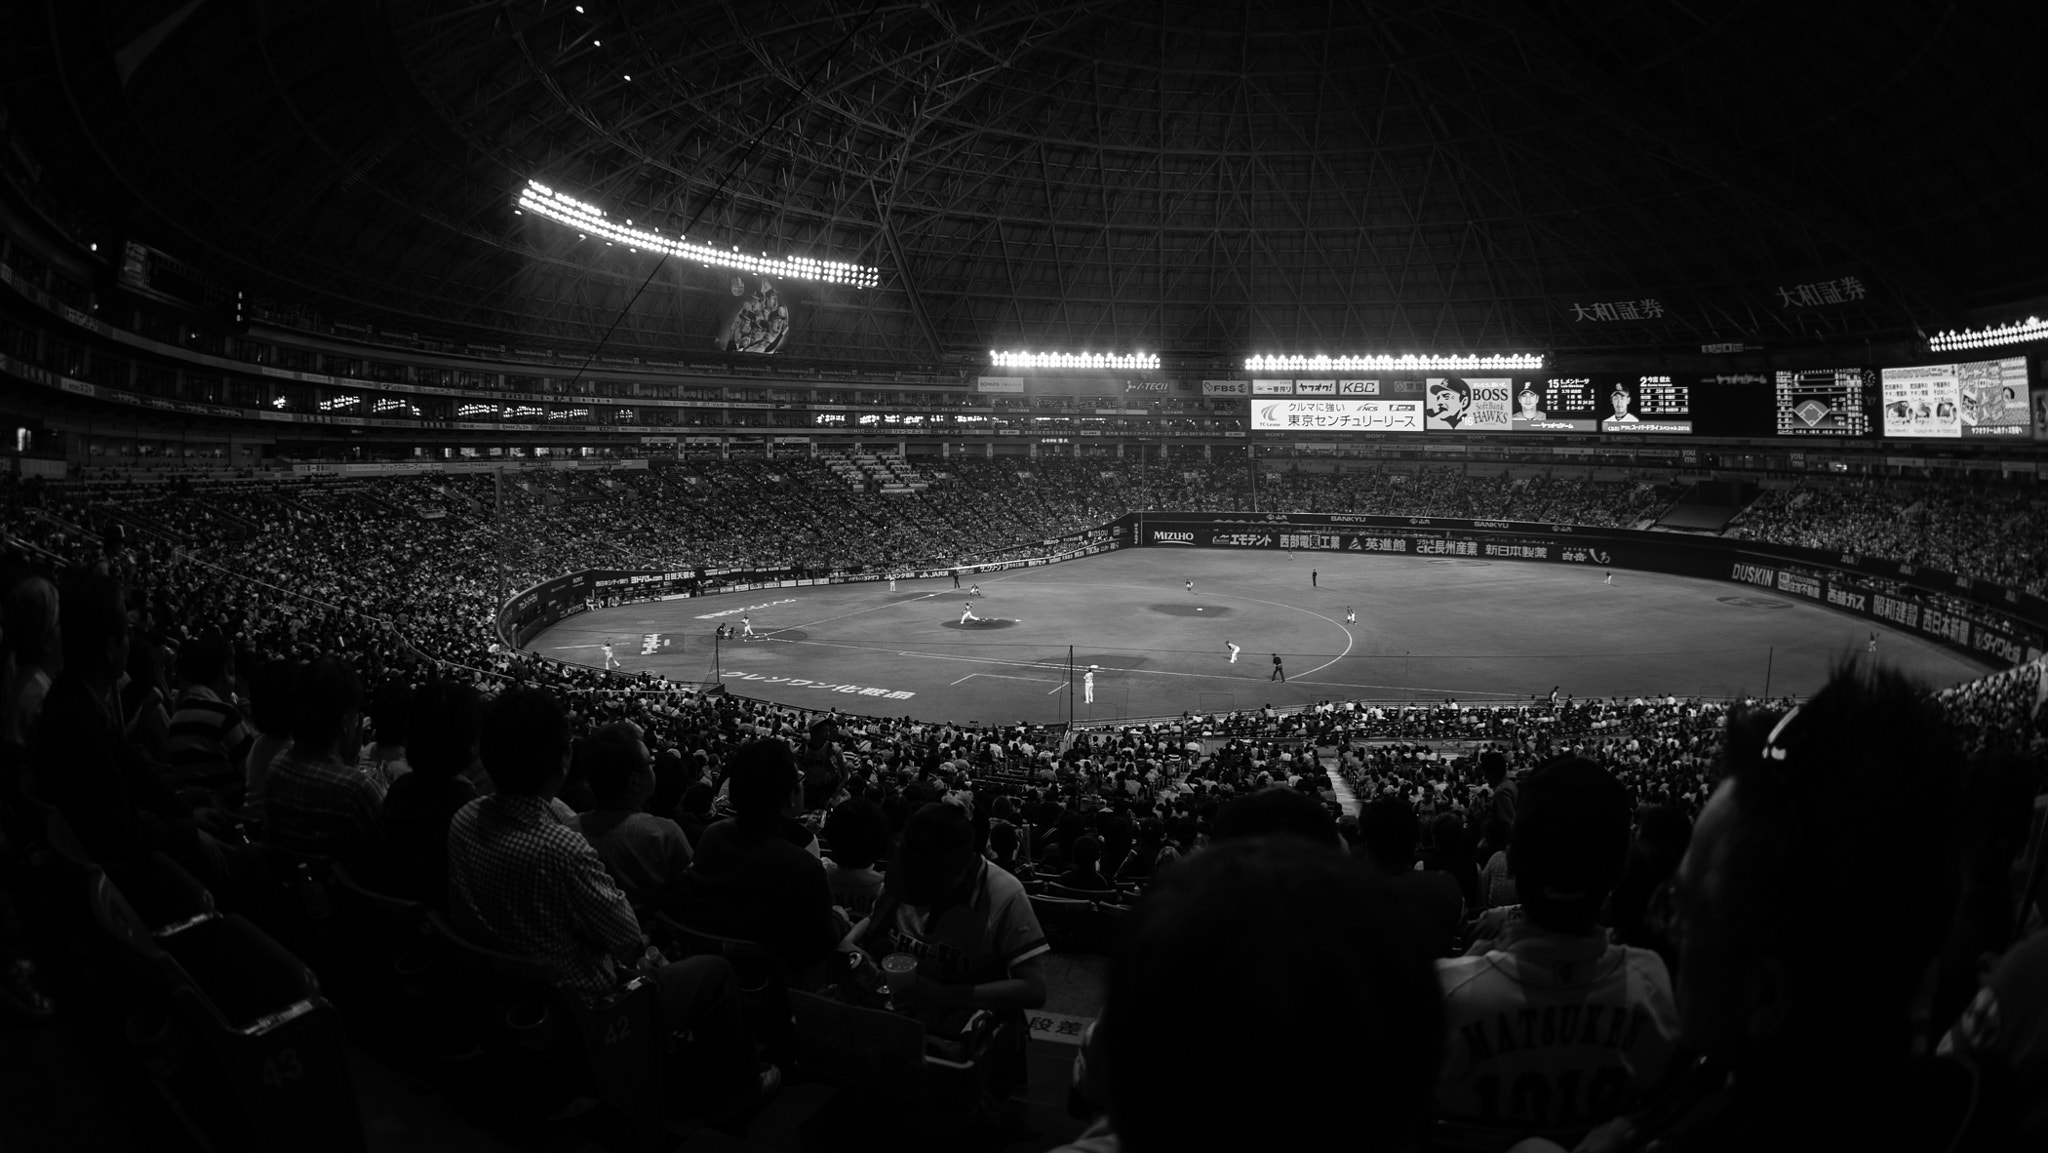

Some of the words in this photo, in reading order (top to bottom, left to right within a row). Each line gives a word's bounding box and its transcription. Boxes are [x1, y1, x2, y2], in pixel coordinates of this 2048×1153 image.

[1775, 276, 1866, 309] 大和証券
[1568, 299, 1664, 322] 大和証券
[1299, 383, 1333, 392] ヤフオク!
[1343, 383, 1375, 393] KBC
[1547, 379, 1559, 388] 15
[1640, 376, 1647, 387] 2
[1472, 388, 1509, 401] BOSS
[1288, 402, 1345, 412] クルマに強い
[1288, 414, 1415, 427] 東京センチュリーリース
[1472, 410, 1509, 424] HAWKS
[1681, 449, 1696, 458] you
[1789, 452, 1804, 462] you
[1792, 460, 1804, 468] me
[1330, 515, 1366, 523] SANKYU
[1473, 520, 1509, 529] SANKYU
[1153, 530, 1194, 541] MIZUHO
[1229, 534, 1272, 546] エモテント
[1279, 534, 1340, 549] 西部電気工業
[1365, 537, 1406, 552] 英進館
[1434, 540, 1478, 556] 長州産業
[1485, 544, 1547, 559] 新日本製薬
[1732, 563, 1774, 587] DUSKIN
[1827, 588, 1866, 611] 西部ガス
[1873, 594, 1918, 628] 昭和建設
[1922, 607, 1970, 646] 西日本新聞
[604, 1016, 632, 1045] 42
[1030, 1016, 1084, 1037] 段差
[261, 1047, 304, 1087] 43
